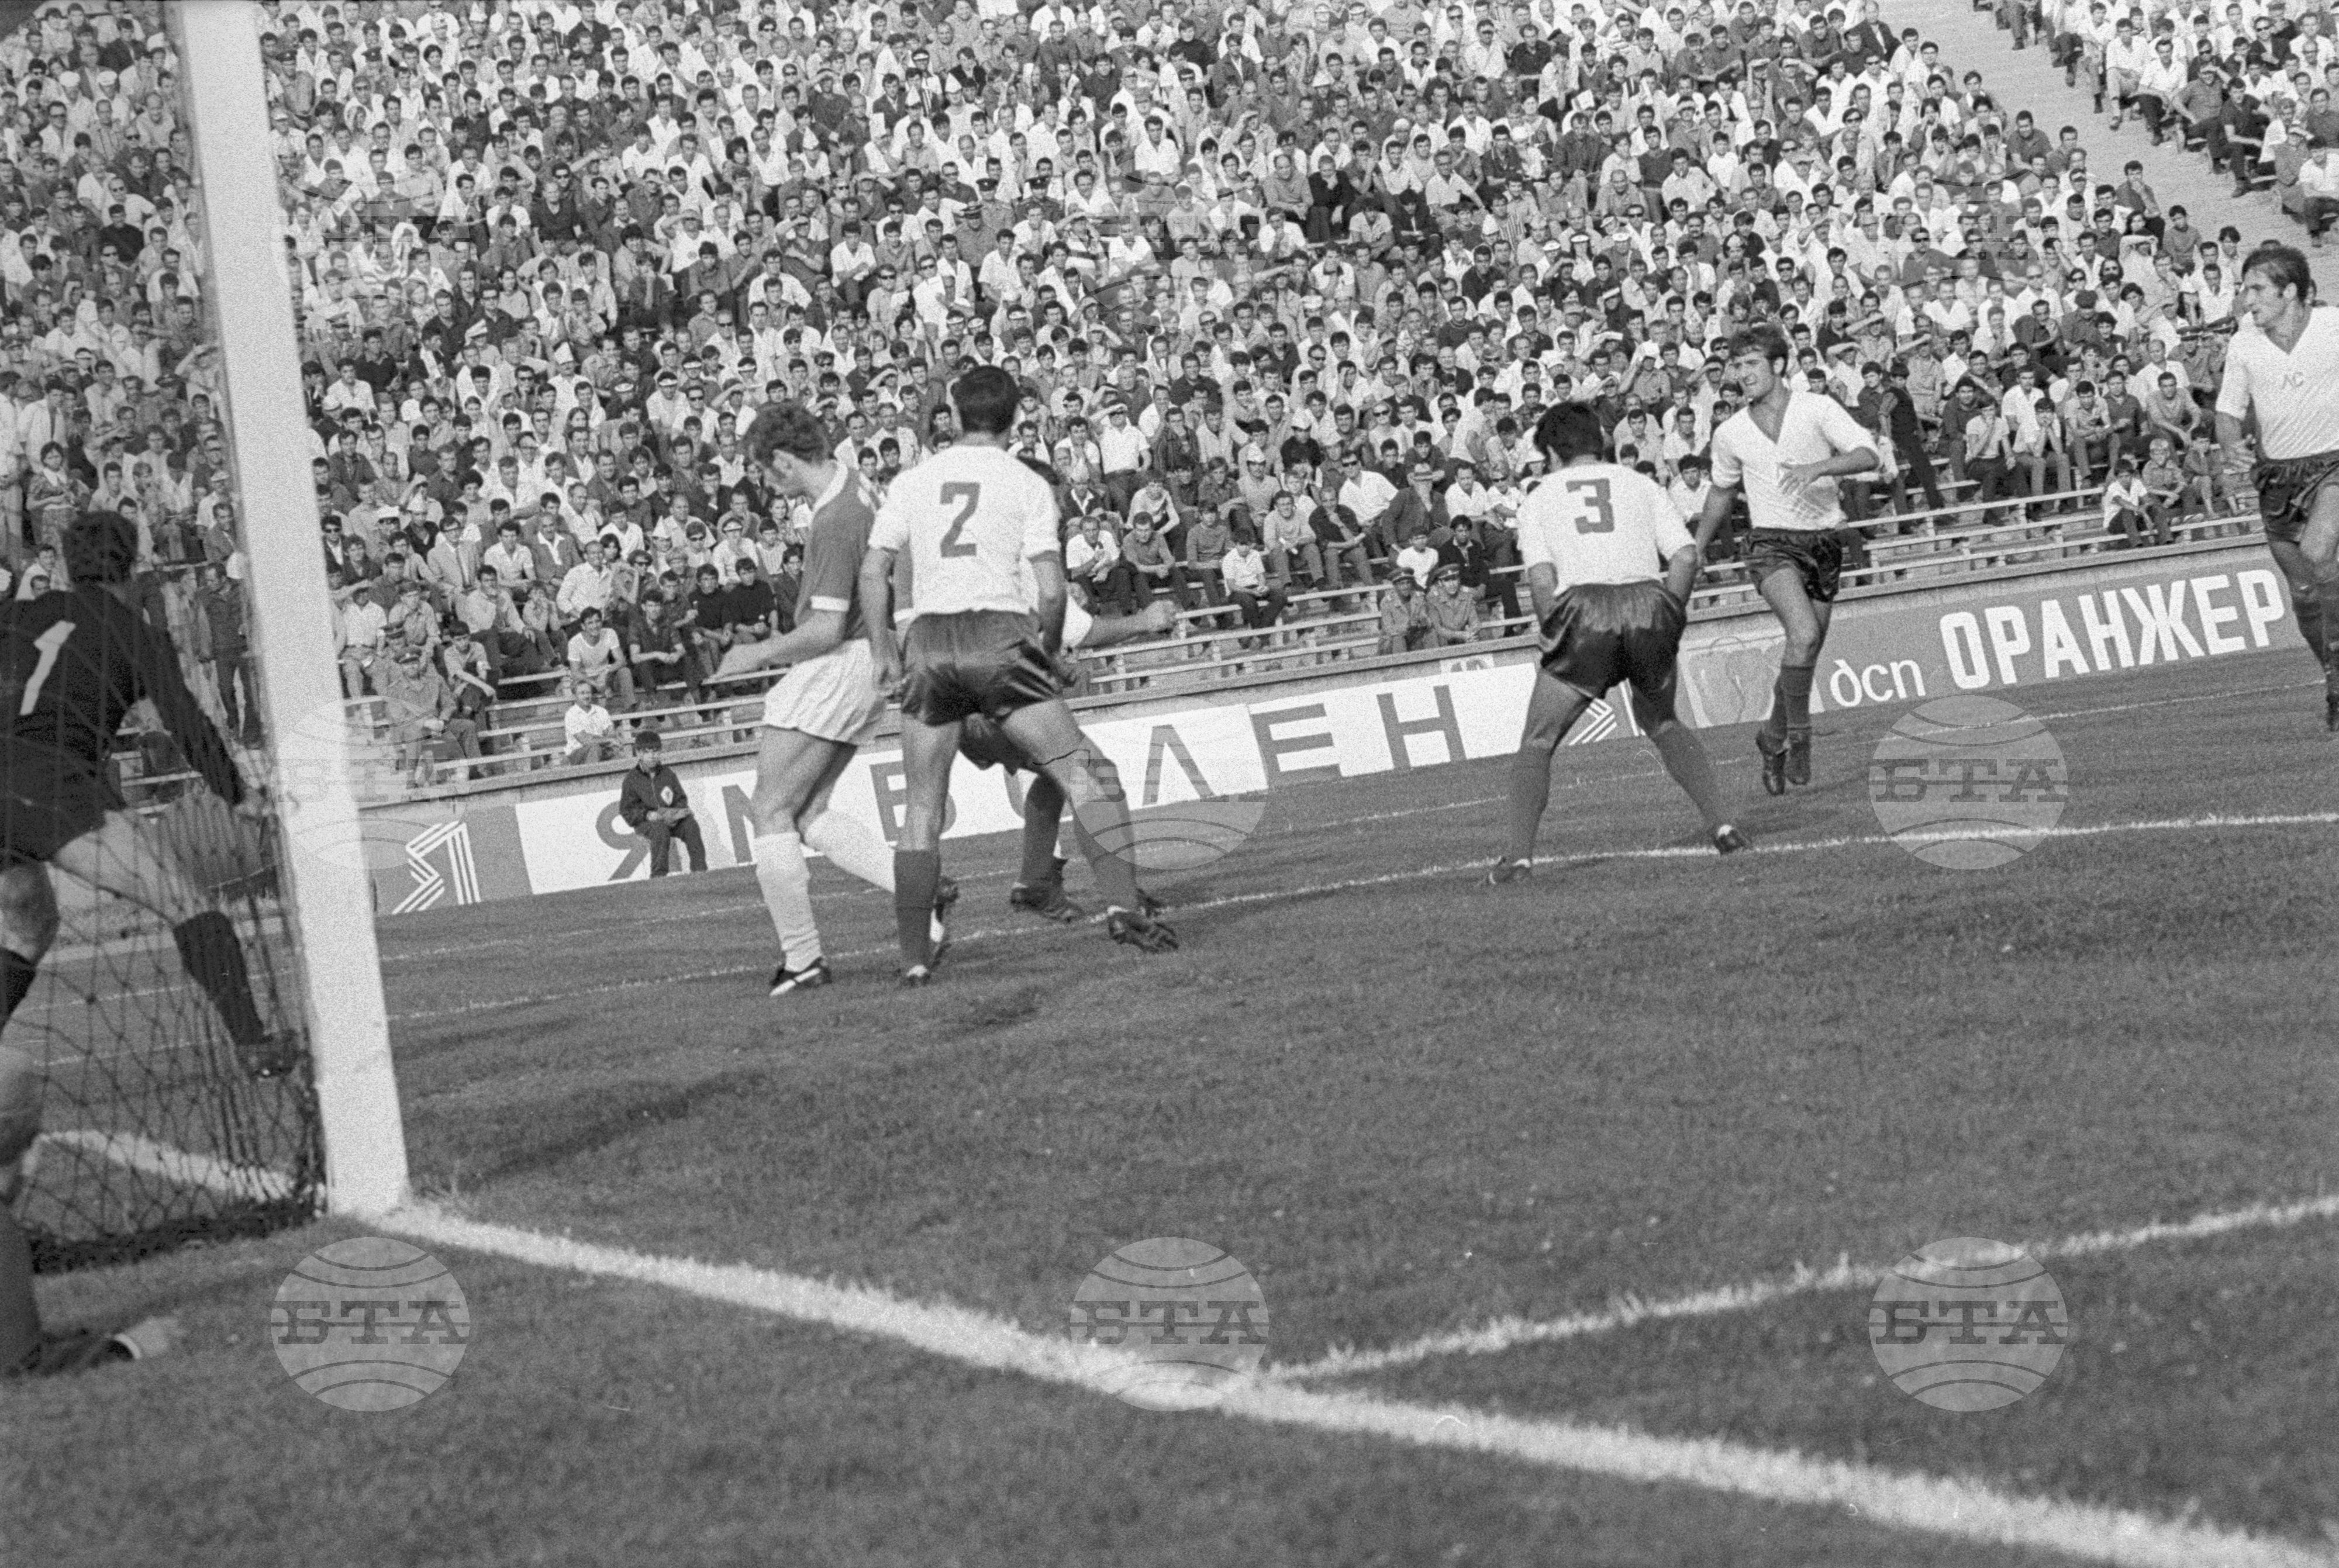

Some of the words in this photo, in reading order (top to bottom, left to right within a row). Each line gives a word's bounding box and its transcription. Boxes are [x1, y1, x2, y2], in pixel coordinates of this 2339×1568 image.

[940, 481, 981, 558] 2
[1565, 478, 1615, 534] 3
[19, 620, 76, 716] 1
[1940, 568, 2285, 689] ОРАНЖЕР
